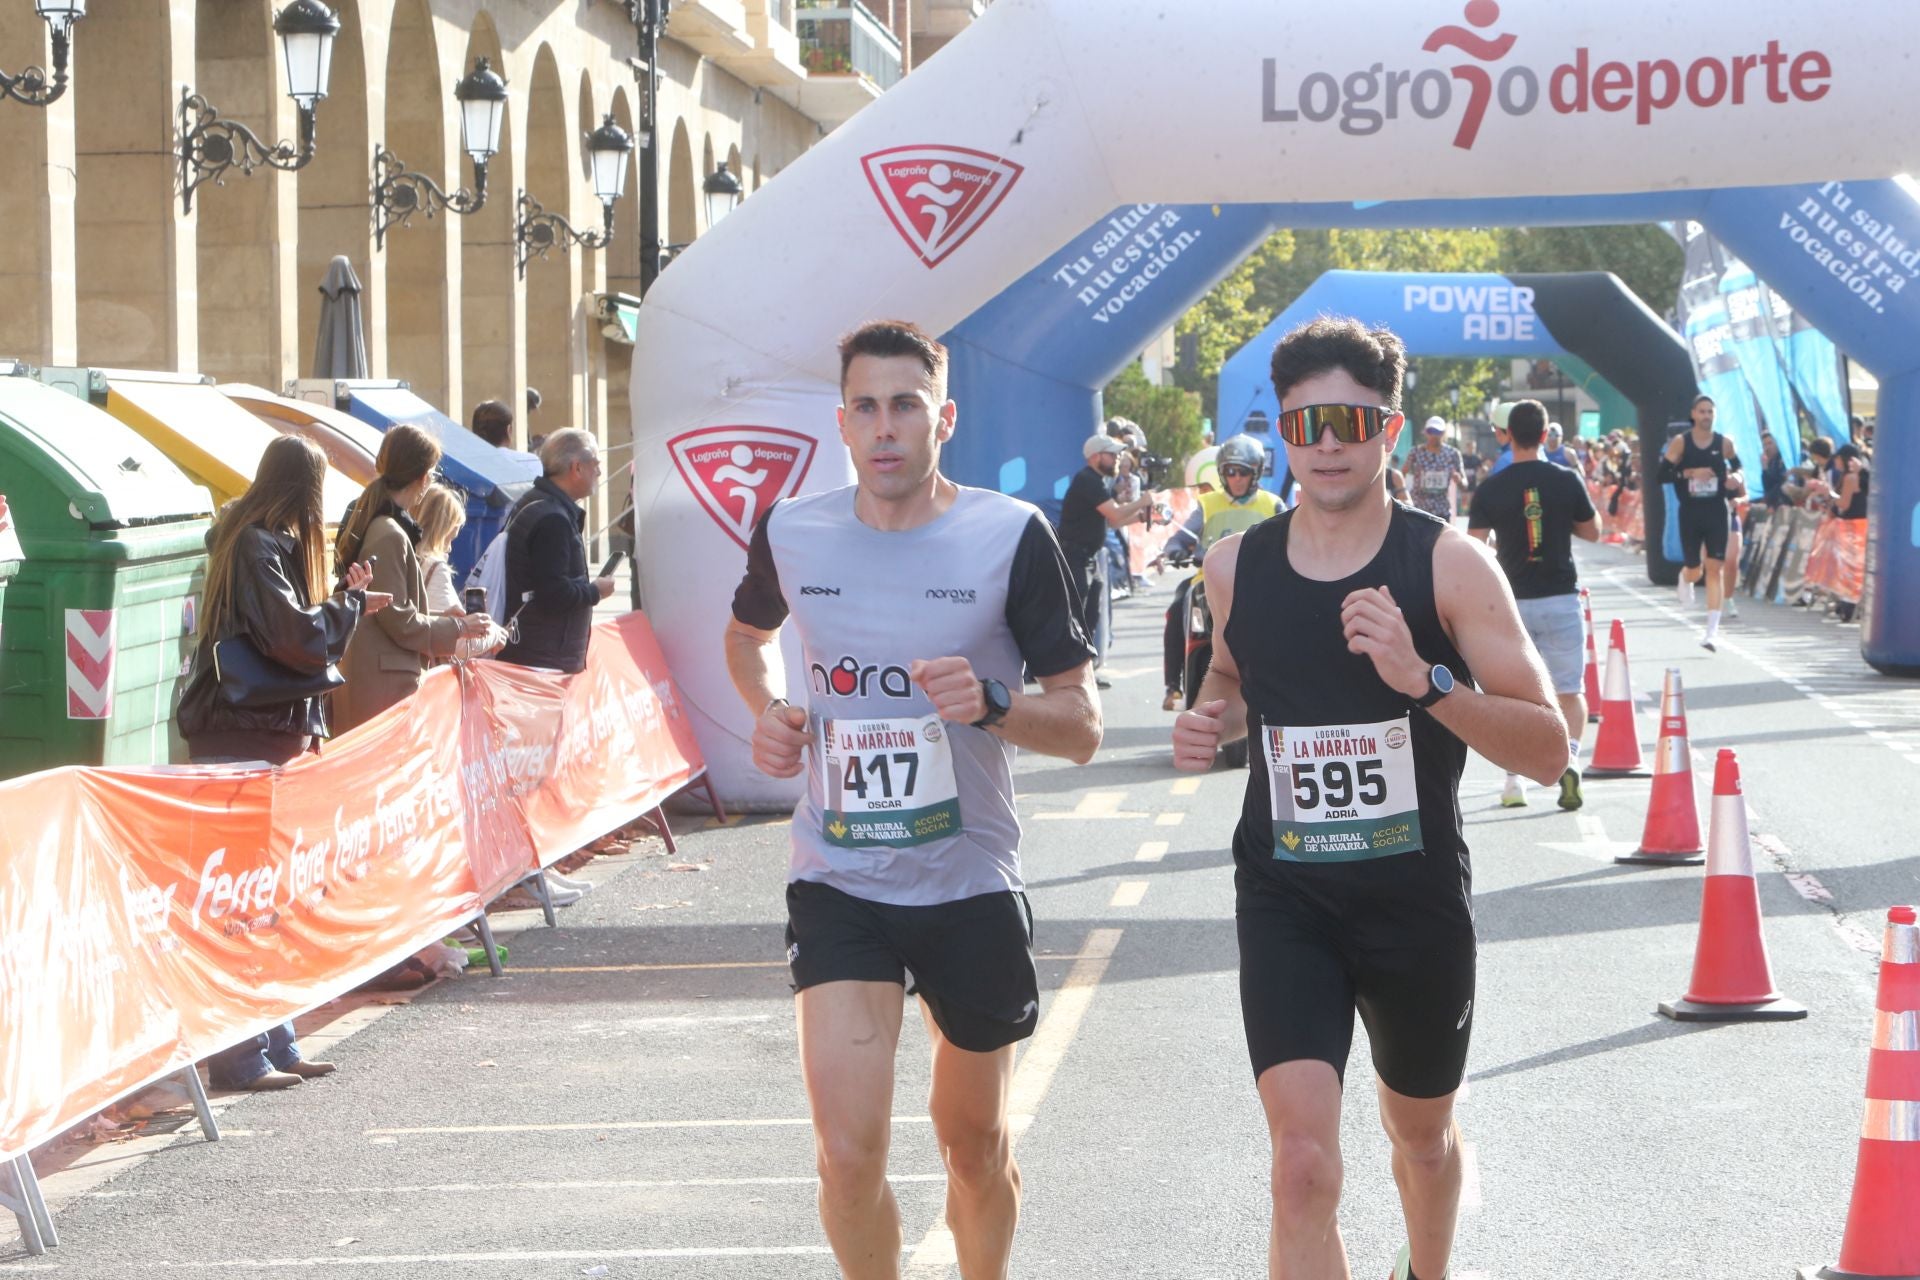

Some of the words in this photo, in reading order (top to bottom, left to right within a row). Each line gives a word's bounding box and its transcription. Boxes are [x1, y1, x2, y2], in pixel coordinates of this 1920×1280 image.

[1549, 40, 1832, 125] deporte
[888, 164, 928, 178] Logroño
[953, 169, 992, 186] deporte
[1797, 196, 1906, 294] nuestra
[1077, 209, 1181, 307] nuestra
[1779, 211, 1885, 314] vocación.
[1053, 255, 1095, 289] Tu
[1092, 230, 1201, 324] vocación.
[1404, 285, 1535, 313] POWER
[1463, 313, 1536, 340] ADE
[692, 448, 729, 464] Logroño
[754, 447, 793, 463] deporte
[925, 589, 976, 599] norave
[858, 722, 891, 732] LOGROÑO
[1315, 729, 1351, 739] LOGROÑO
[841, 733, 854, 750] LA
[857, 729, 916, 750] MARATÓN
[1294, 741, 1310, 758] LA
[1313, 735, 1377, 758] MARATÓN
[844, 752, 919, 799] 417
[1292, 759, 1387, 809] 595
[868, 800, 902, 809] OSCAR
[1325, 807, 1359, 819] ADRIÀ
[850, 823, 874, 832] CAJA
[874, 822, 907, 831] RURAL
[914, 811, 950, 827] ACCIÓN
[852, 831, 866, 840] DE
[867, 830, 912, 840] NAVARRA
[915, 822, 951, 836] SOCIAL
[1304, 835, 1328, 844] CAJA
[1329, 833, 1364, 842] RURAL
[1372, 824, 1409, 839] ACCIÓN
[1305, 844, 1319, 852] DE
[1320, 841, 1370, 852] NAVARRA
[1373, 835, 1410, 848] SOCIAL
[190, 847, 283, 931] ferrer
